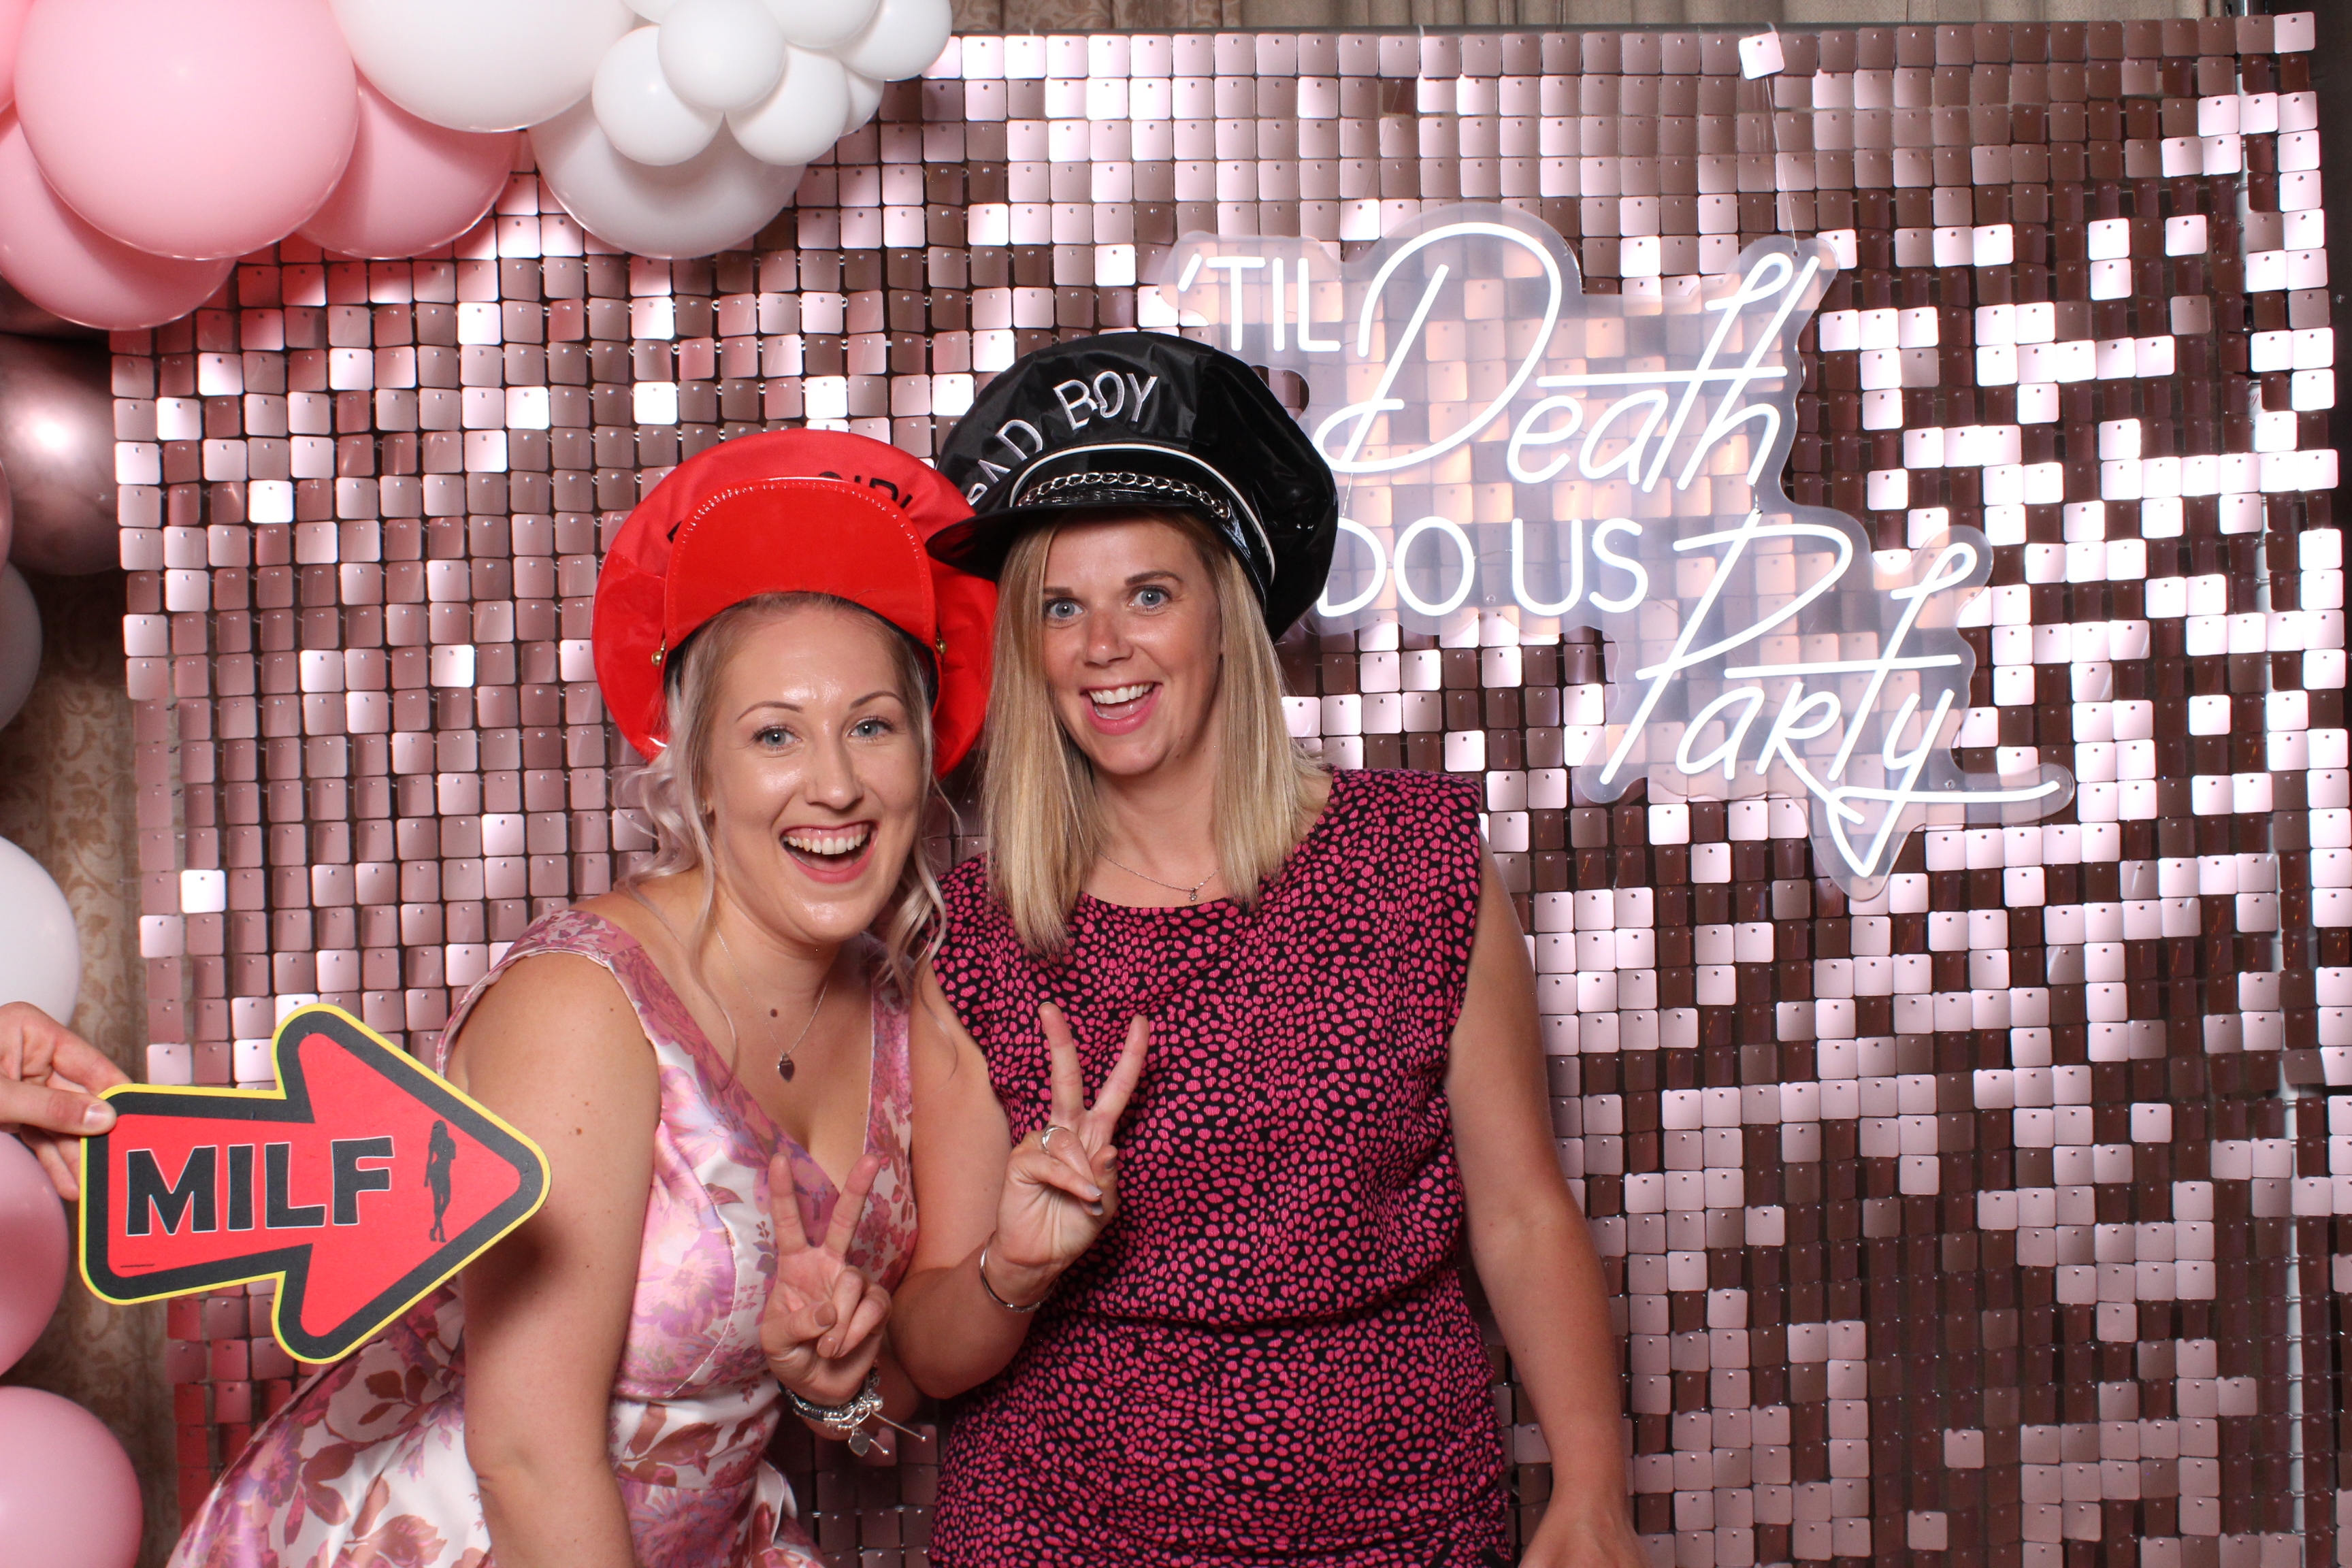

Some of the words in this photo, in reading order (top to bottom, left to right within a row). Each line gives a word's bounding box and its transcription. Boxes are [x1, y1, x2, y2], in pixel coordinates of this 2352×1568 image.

[1053, 371, 1157, 430] BOY
[1313, 222, 1820, 492] Death
[1316, 516, 1475, 617] DO
[1512, 518, 1648, 616] US
[126, 1136, 395, 1237] MILF
